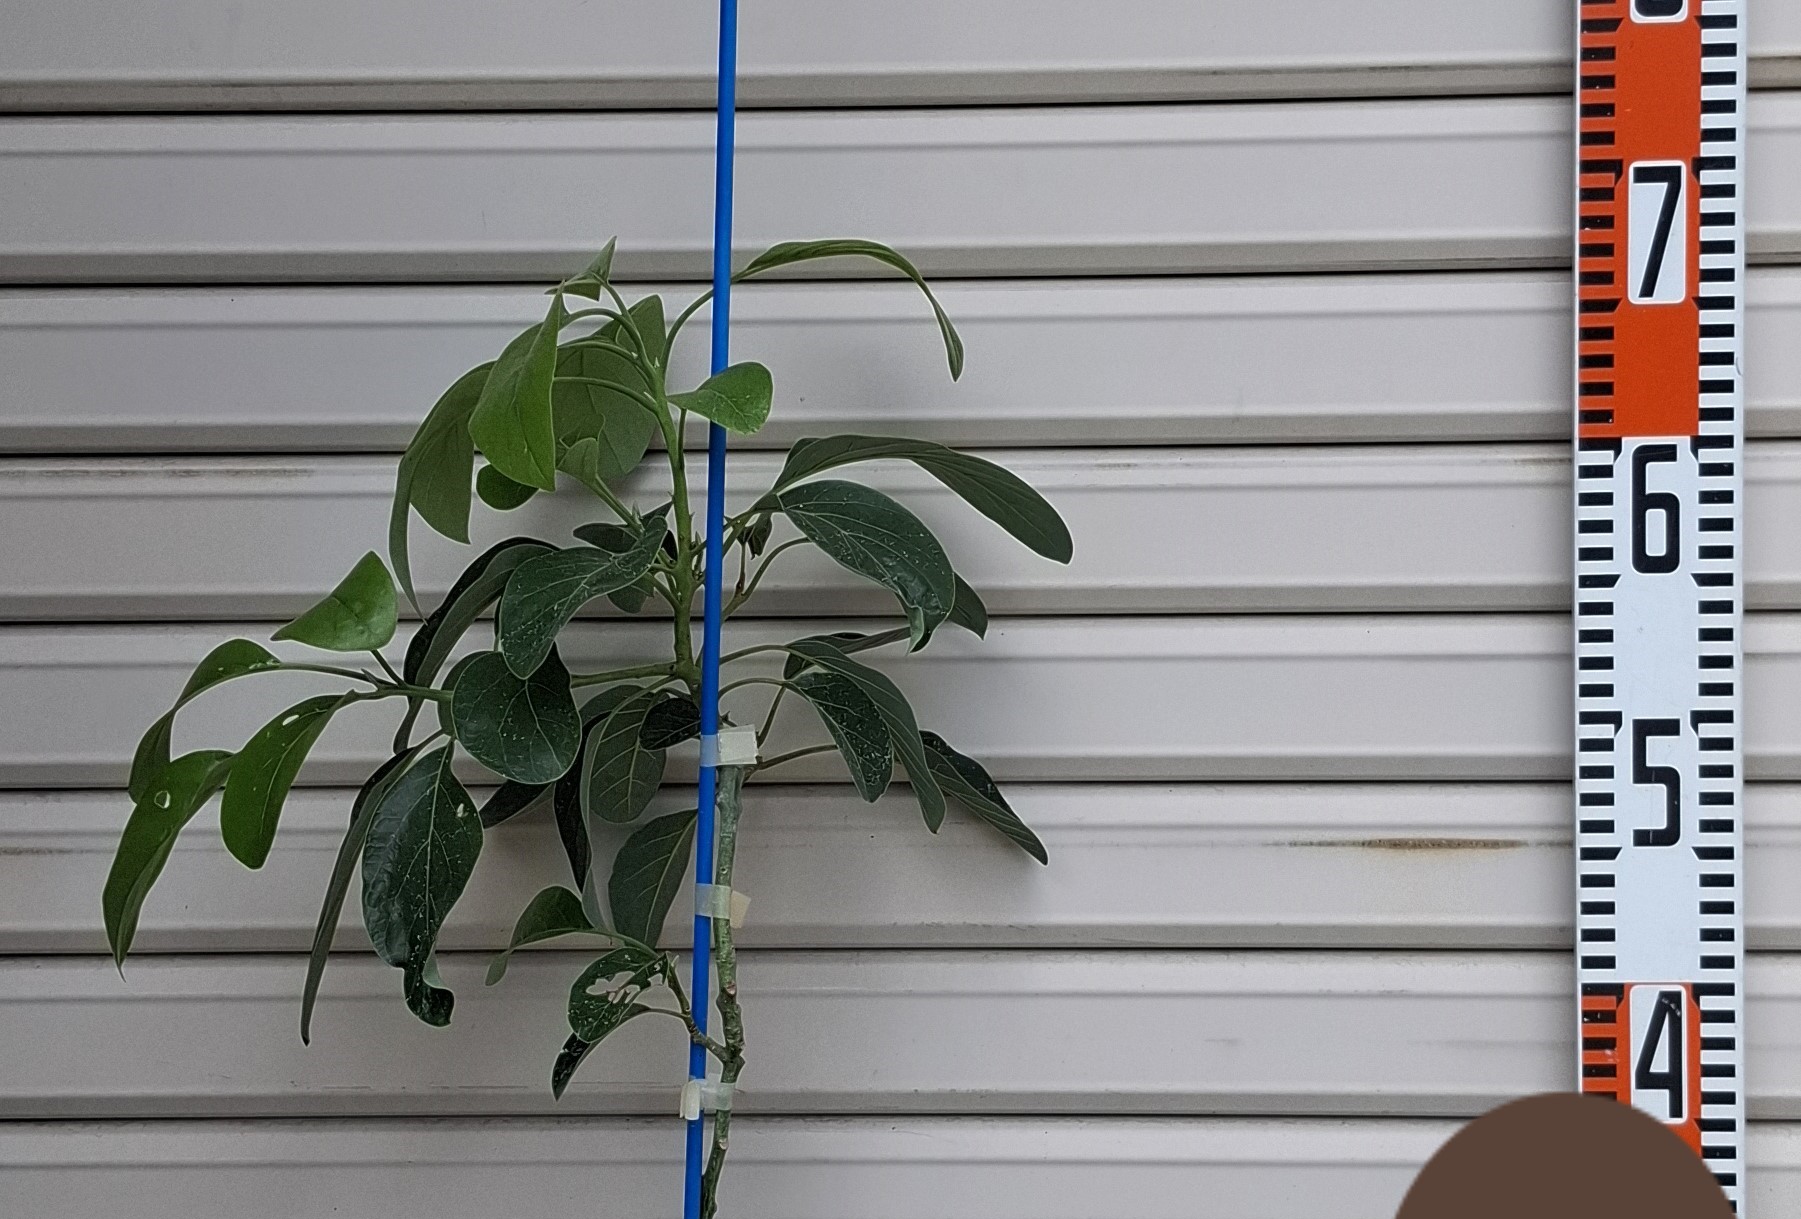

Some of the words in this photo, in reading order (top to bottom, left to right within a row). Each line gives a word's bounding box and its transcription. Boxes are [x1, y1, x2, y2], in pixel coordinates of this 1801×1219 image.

[1632, 165, 1682, 298] 7
[1631, 444, 1680, 573] 6
[1632, 718, 1681, 846] 5
[1635, 990, 1683, 1118] 4
